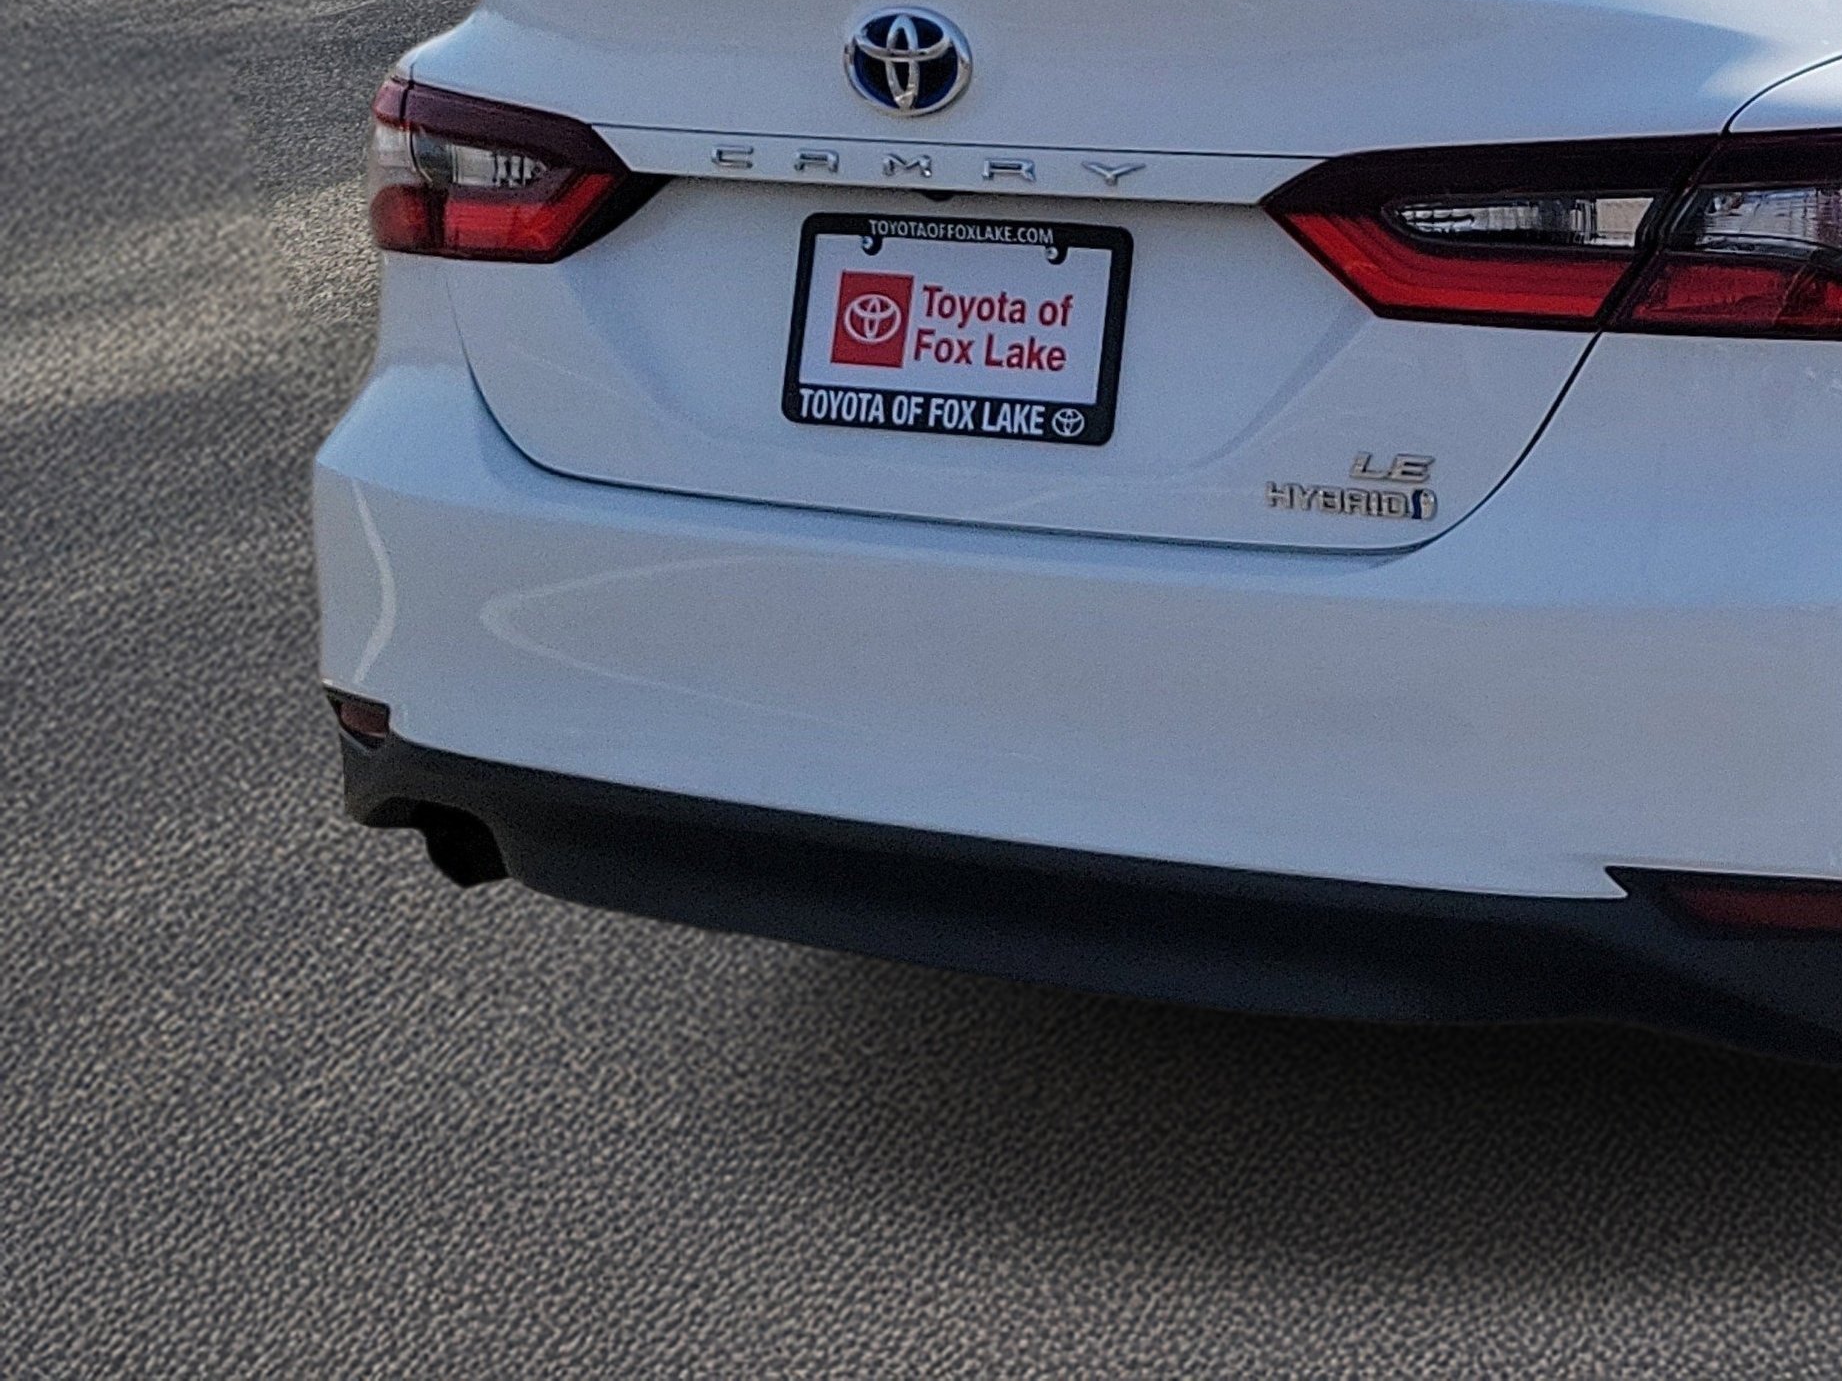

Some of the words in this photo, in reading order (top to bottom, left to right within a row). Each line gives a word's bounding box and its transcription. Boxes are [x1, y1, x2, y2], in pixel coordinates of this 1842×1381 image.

[710, 144, 1146, 186] CAMRY
[869, 219, 1054, 244] TOYOTAOFFOXLAKE.COM
[923, 284, 1026, 328] Toyota
[1038, 293, 1074, 327] of
[913, 328, 975, 365] Fox
[984, 333, 1067, 371] Lake
[800, 388, 885, 423] TOYOTA
[892, 395, 924, 425] OF
[928, 398, 977, 431] FOX
[981, 401, 1045, 435] LAKE
[1350, 451, 1436, 483] LE
[1264, 480, 1410, 519] HYBRID
